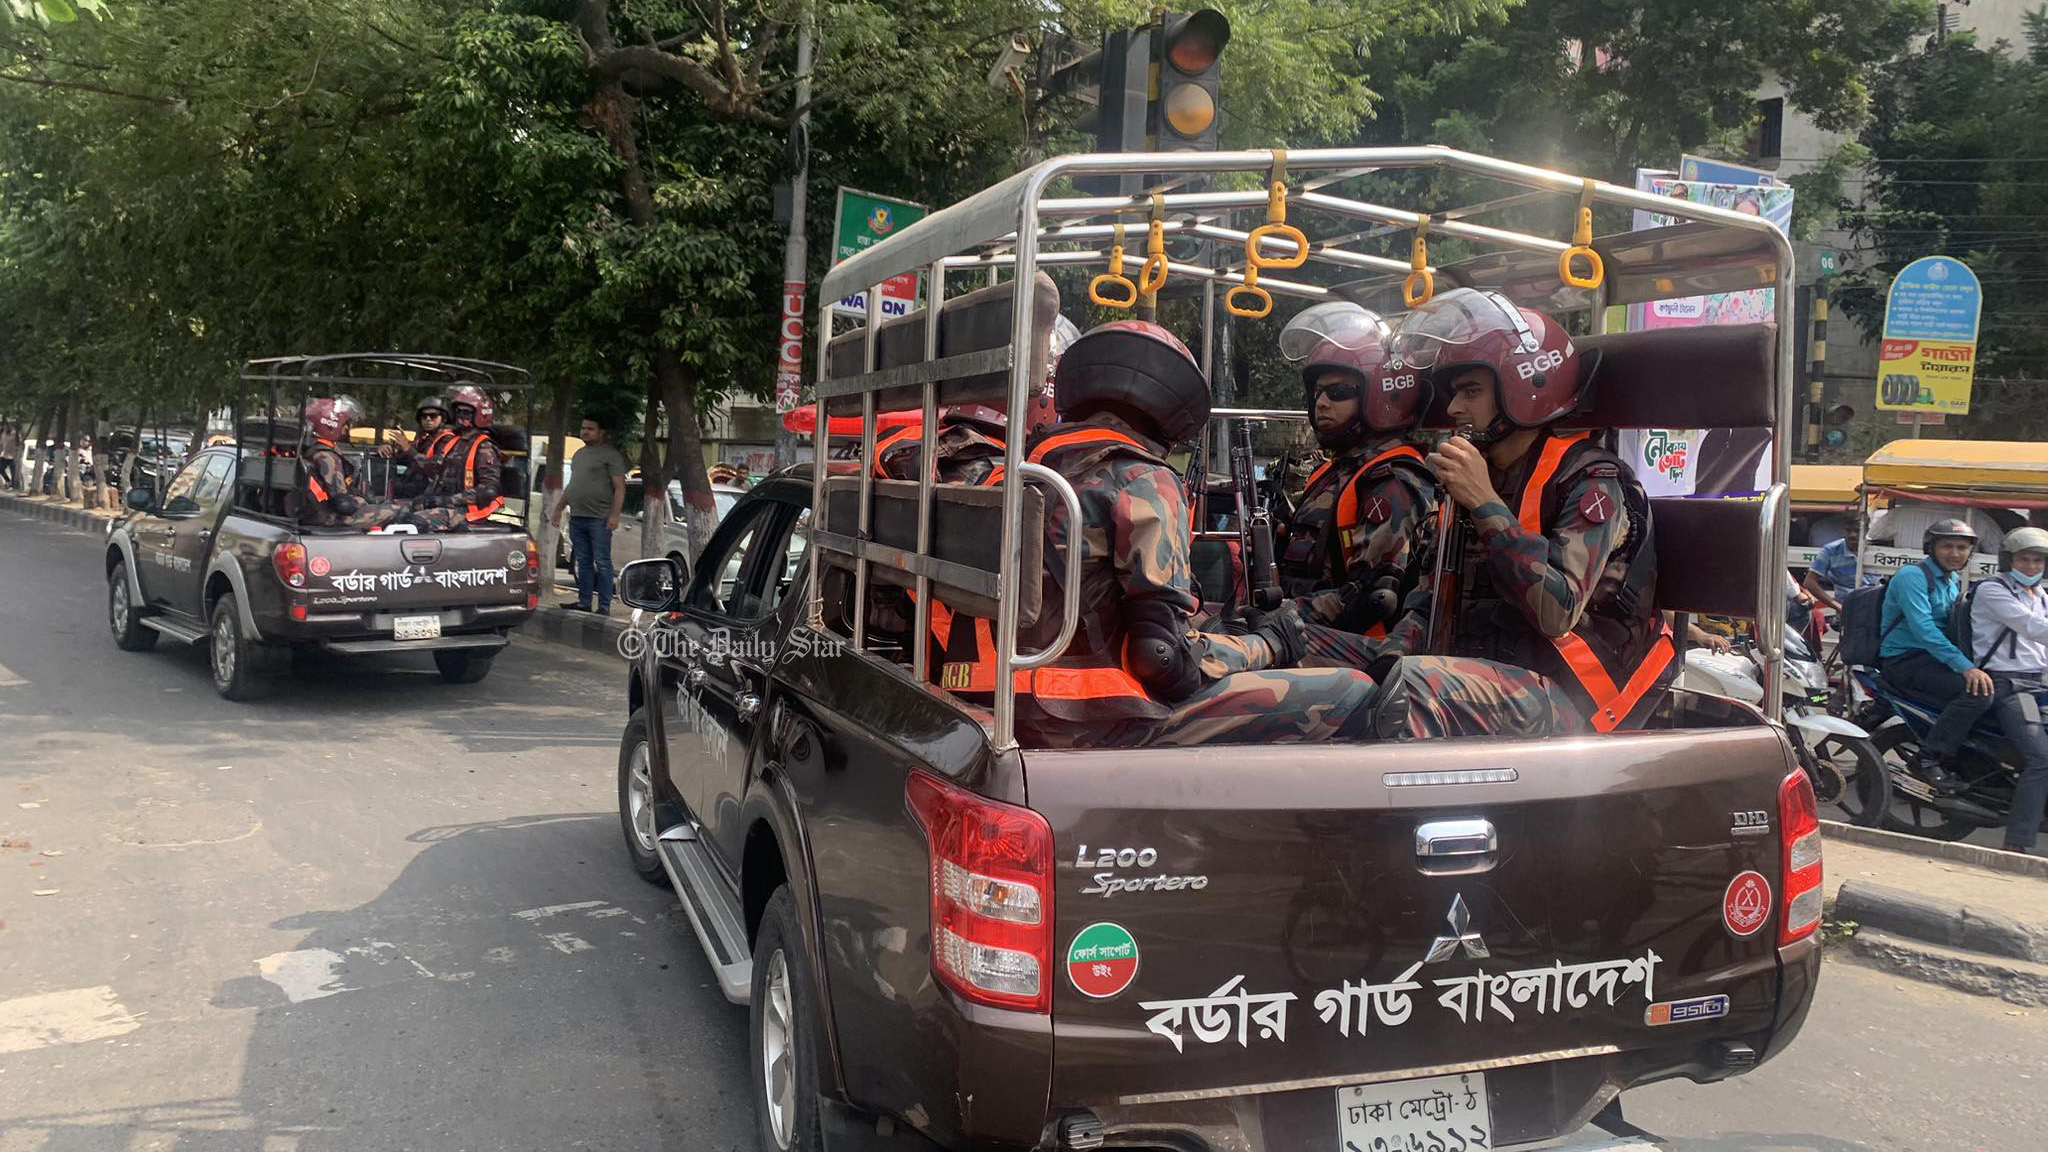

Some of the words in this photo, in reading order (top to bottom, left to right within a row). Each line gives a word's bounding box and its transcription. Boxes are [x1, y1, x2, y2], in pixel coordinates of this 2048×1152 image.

[840, 294, 906, 316] WAON
[1516, 349, 1564, 380] BGB
[1382, 374, 1416, 392] BGB
[1659, 451, 1687, 473] ভোট
[330, 569, 377, 593] বর্ডার
[380, 566, 414, 590] গার্ড
[433, 566, 508, 589] বাংলাদেশ
[1074, 844, 1158, 868] L200
[1079, 872, 1209, 898] Sportero
[1074, 944, 1098, 960] ফোর্স
[1098, 941, 1132, 958] সাপোর্ট
[1091, 963, 1113, 978] উইং
[1138, 974, 1299, 1054] বর্ডার
[1313, 960, 1424, 1038] গার্ড
[1433, 948, 1664, 1024] বাংলাদেশ
[1347, 1100, 1392, 1125] ঢাকা
